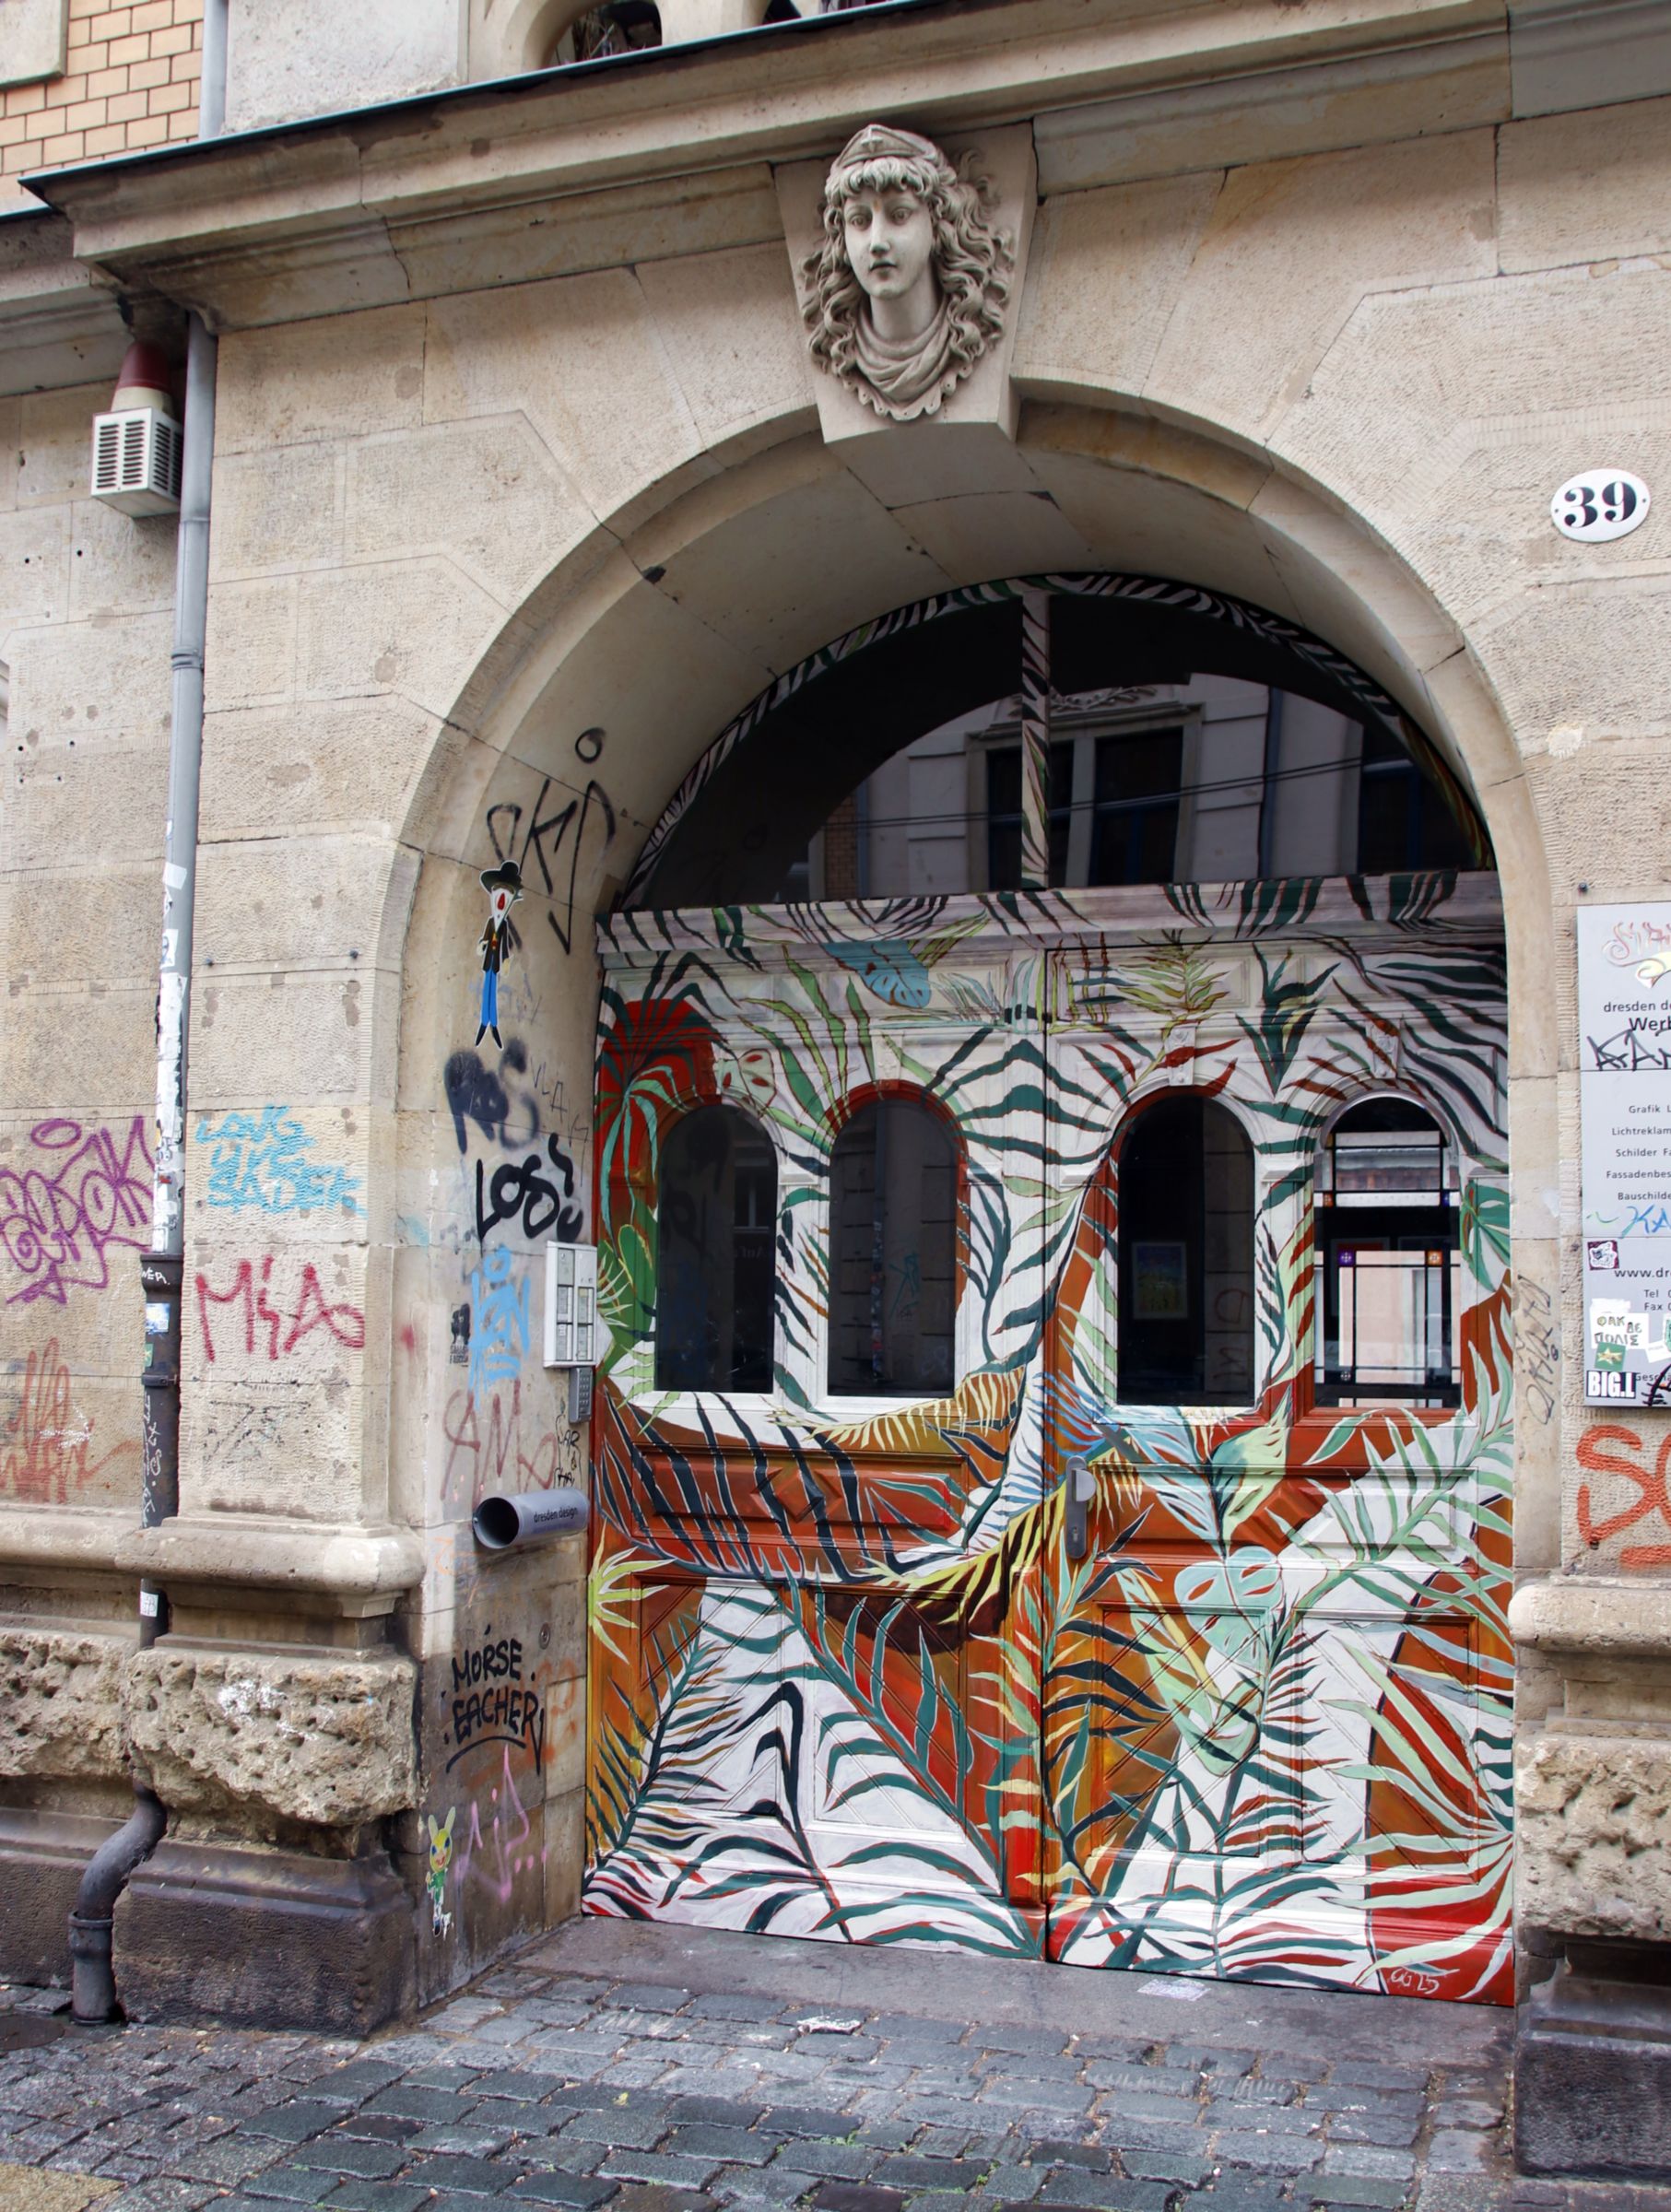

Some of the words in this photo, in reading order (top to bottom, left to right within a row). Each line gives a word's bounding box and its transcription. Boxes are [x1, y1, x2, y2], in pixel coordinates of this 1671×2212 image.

[1563, 480, 1637, 529] 39
[1604, 1001, 1656, 1013] dresden
[1628, 1104, 1661, 1113] Grafik
[1616, 1147, 1657, 1158] Schilder
[1614, 1266, 1671, 1278] www.dr
[1644, 1288, 1659, 1298] Tel
[1643, 1301, 1663, 1312] Fax
[1587, 1371, 1636, 1398] BIG.L
[533, 1509, 559, 1524] dresden
[452, 1638, 523, 1693] MORSE
